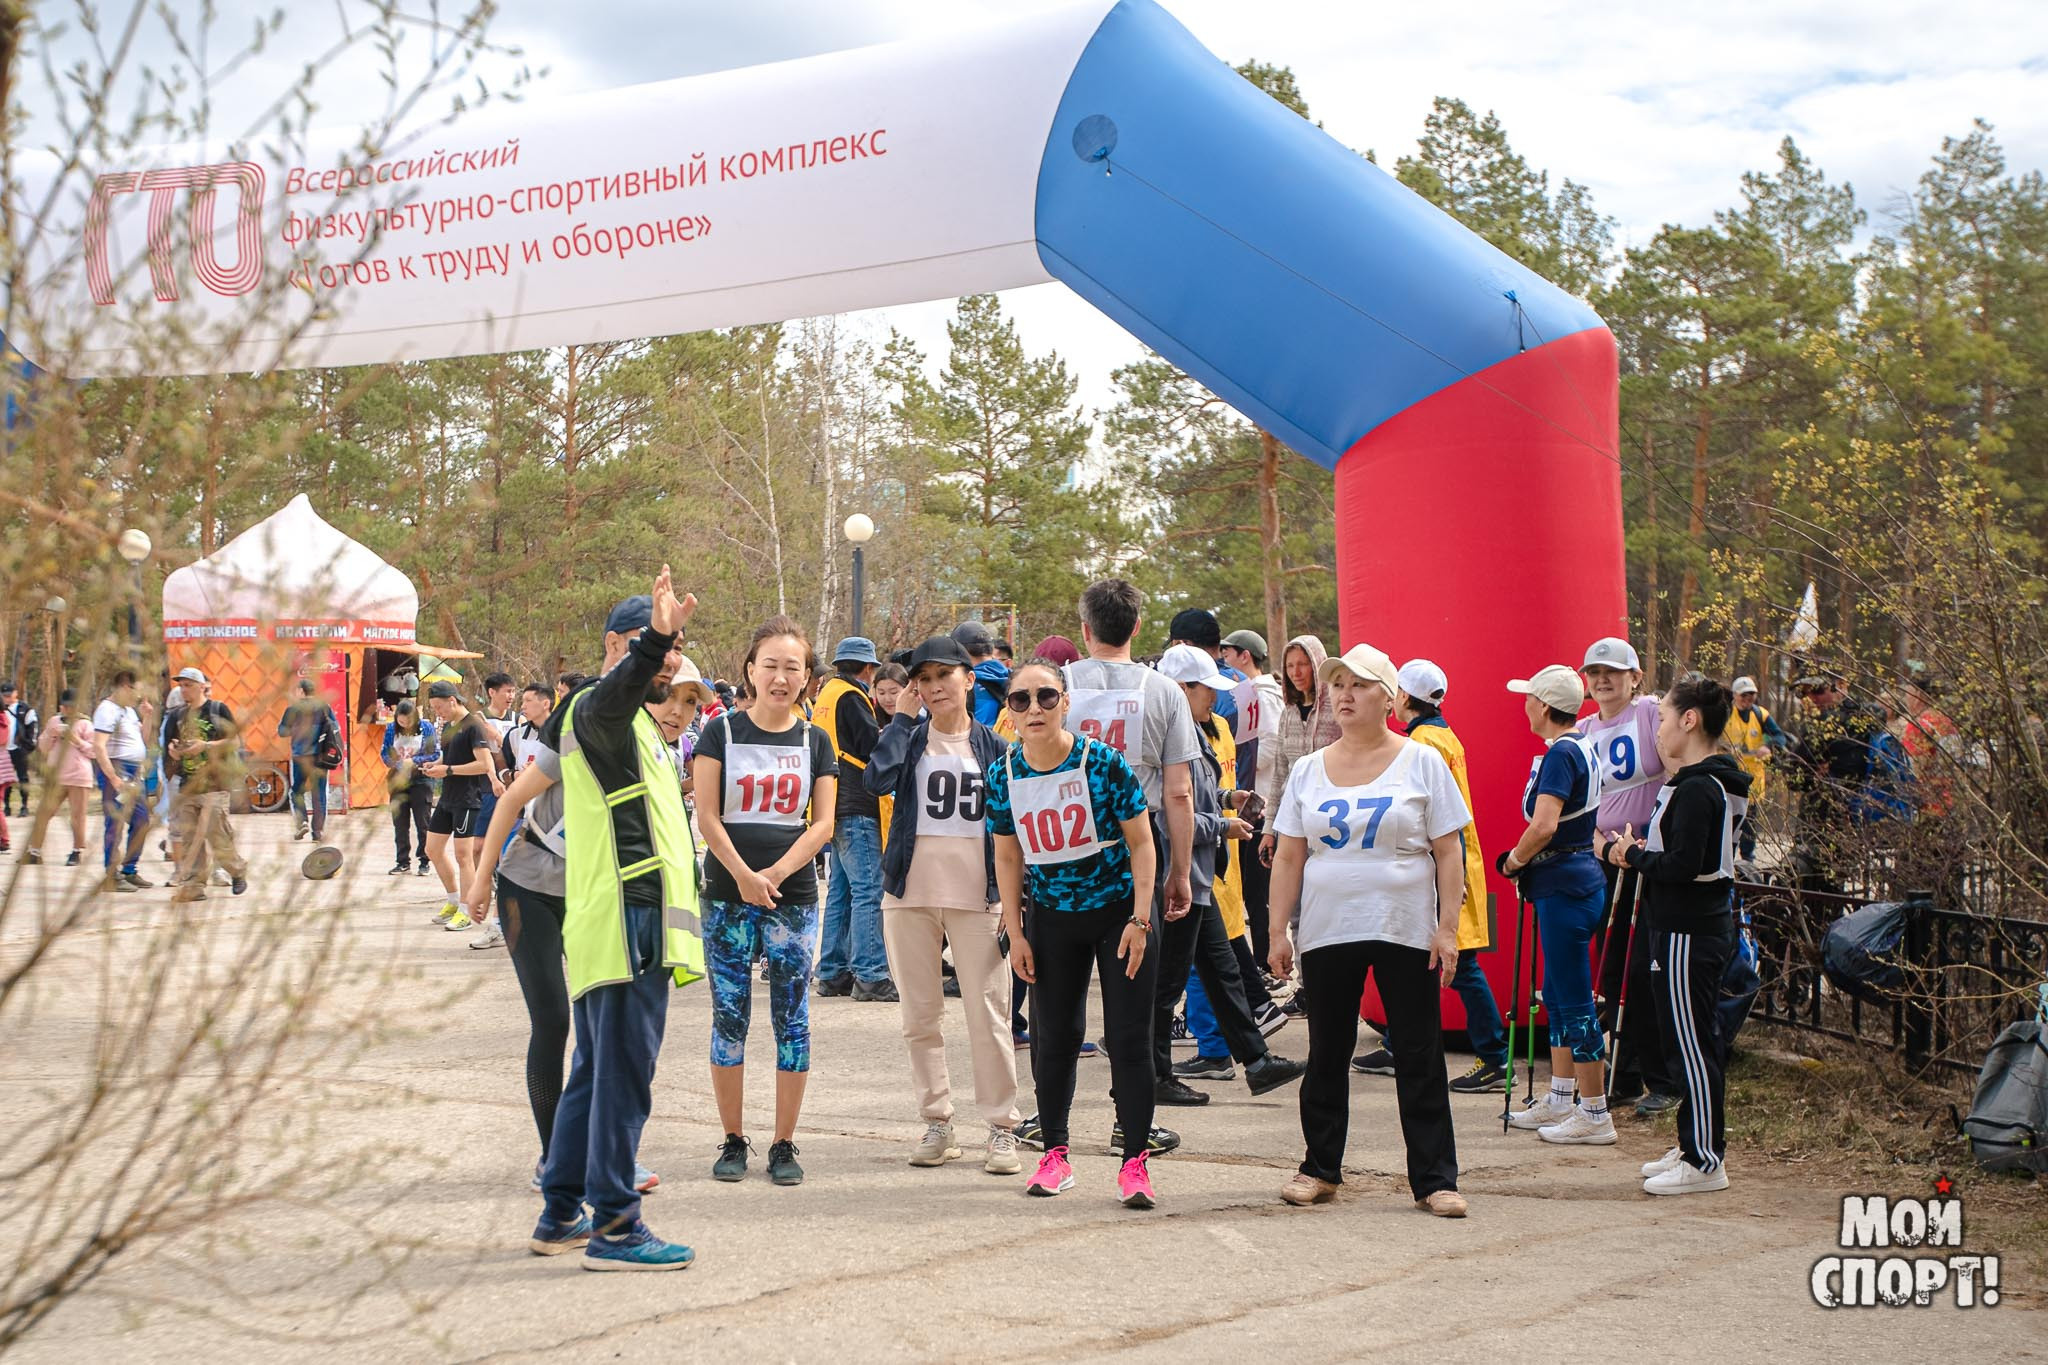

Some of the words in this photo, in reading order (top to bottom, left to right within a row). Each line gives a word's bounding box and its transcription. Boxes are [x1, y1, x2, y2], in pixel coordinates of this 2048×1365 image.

[281, 152, 708, 250] физкультурно-спортивный
[720, 128, 888, 182] комплекс
[285, 138, 520, 197] Всероссийский
[84, 160, 266, 306] ГТО
[399, 255, 418, 280] к
[422, 243, 511, 283] труду
[521, 239, 542, 265] и
[553, 214, 713, 260] обороне»
[1116, 700, 1140, 715] ГТО
[1080, 718, 1127, 753] 34
[777, 754, 801, 769] ГТО
[736, 773, 802, 814] 119
[926, 770, 986, 821] 95
[1058, 780, 1084, 801] ГТО
[1019, 803, 1092, 854] 102
[1317, 796, 1393, 850] 37
